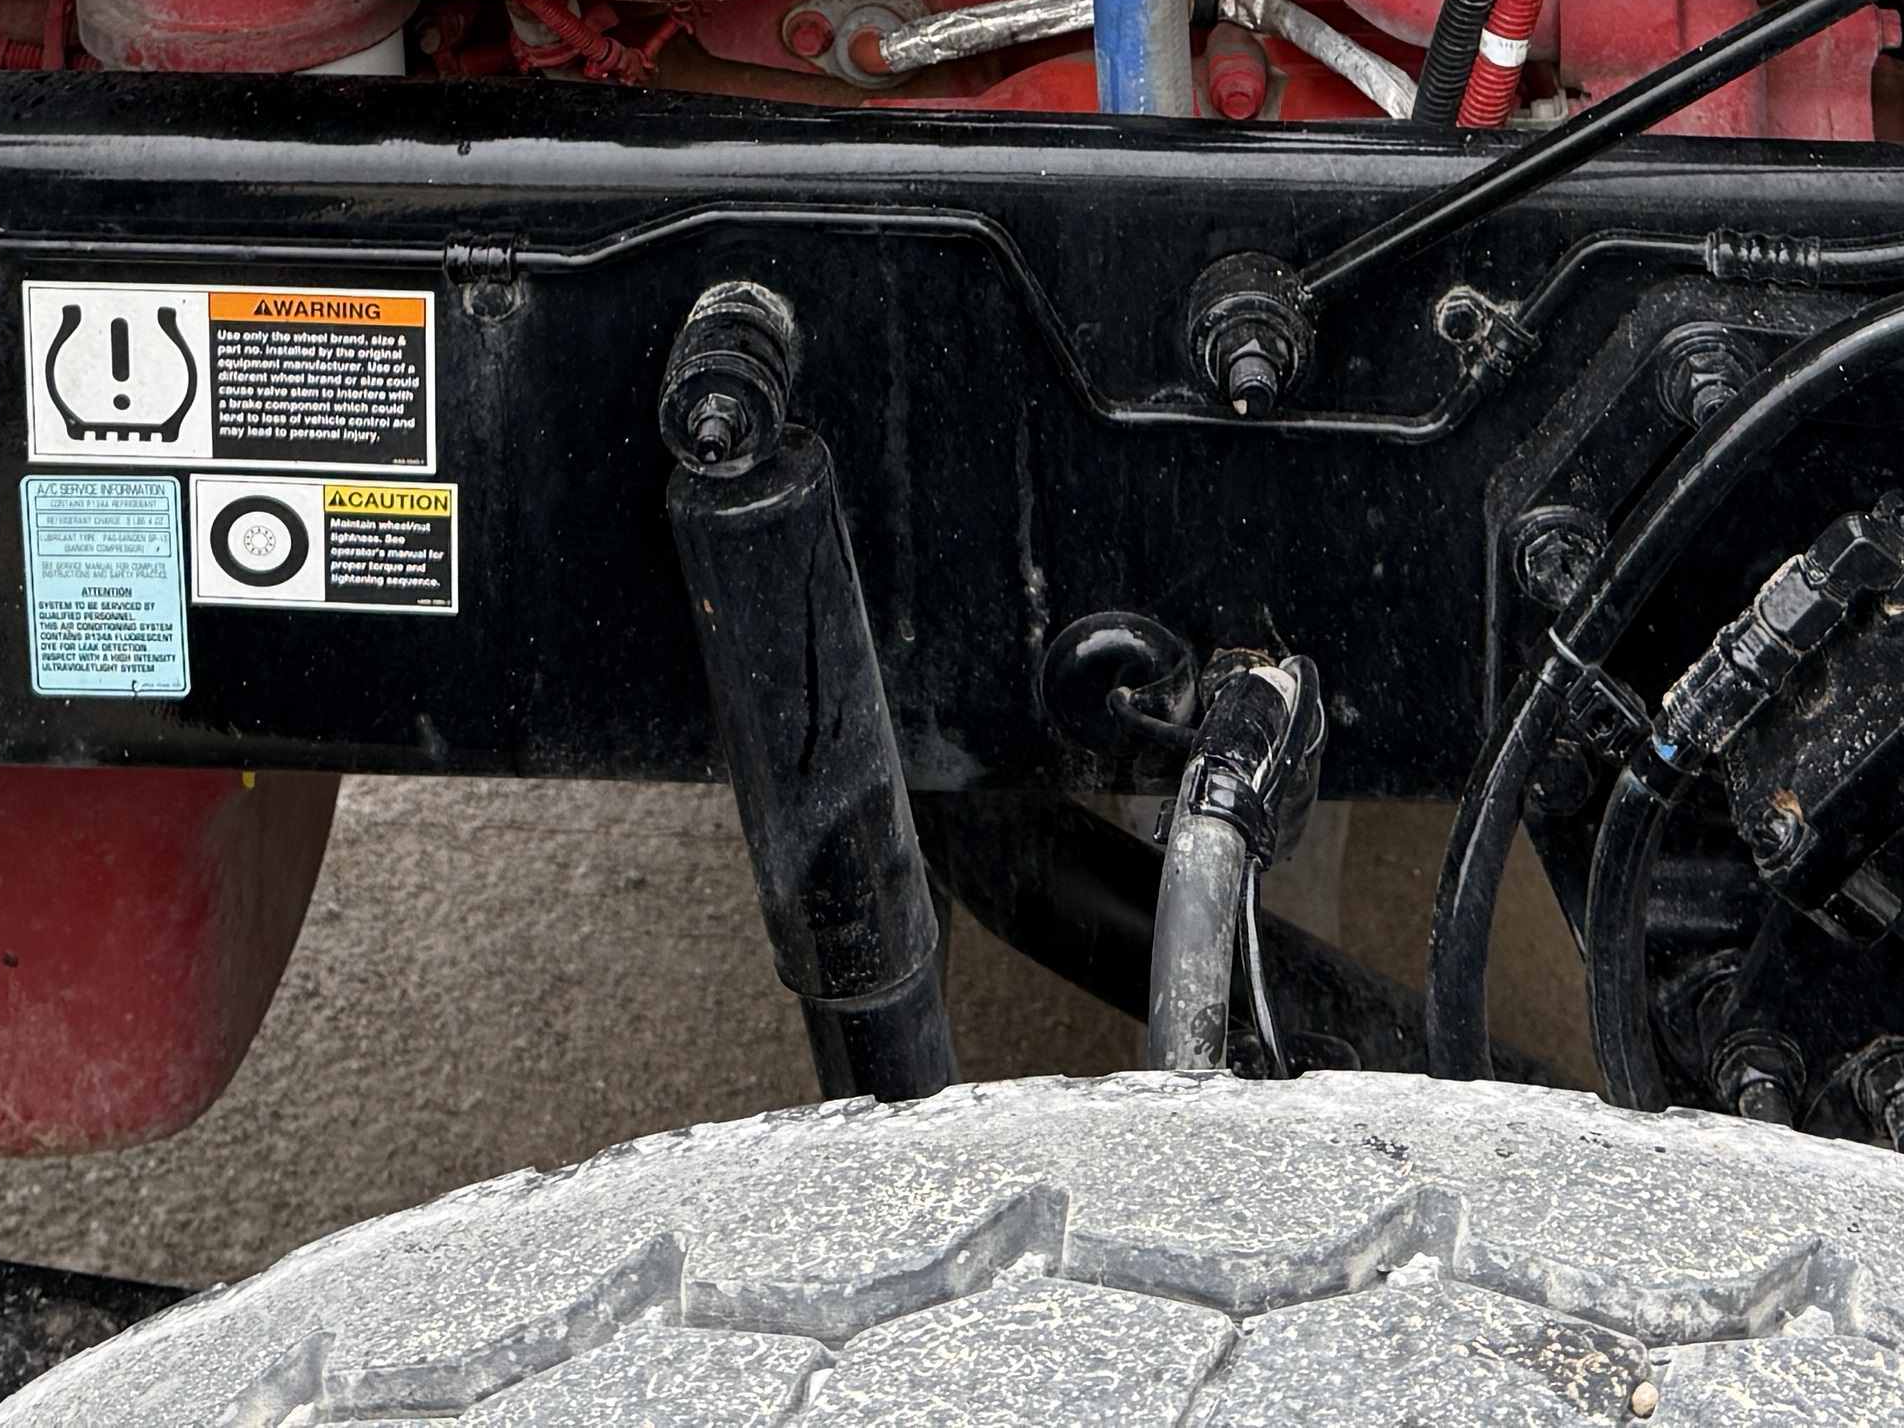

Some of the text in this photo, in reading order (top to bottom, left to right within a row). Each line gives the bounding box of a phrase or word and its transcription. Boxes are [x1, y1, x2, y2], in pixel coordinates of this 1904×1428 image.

[273, 299, 381, 319] WARNING
[38, 483, 165, 495] A/C SERVICE INFORMATION
[348, 492, 448, 512] CAUTION
[81, 586, 132, 598] ATTENTION
